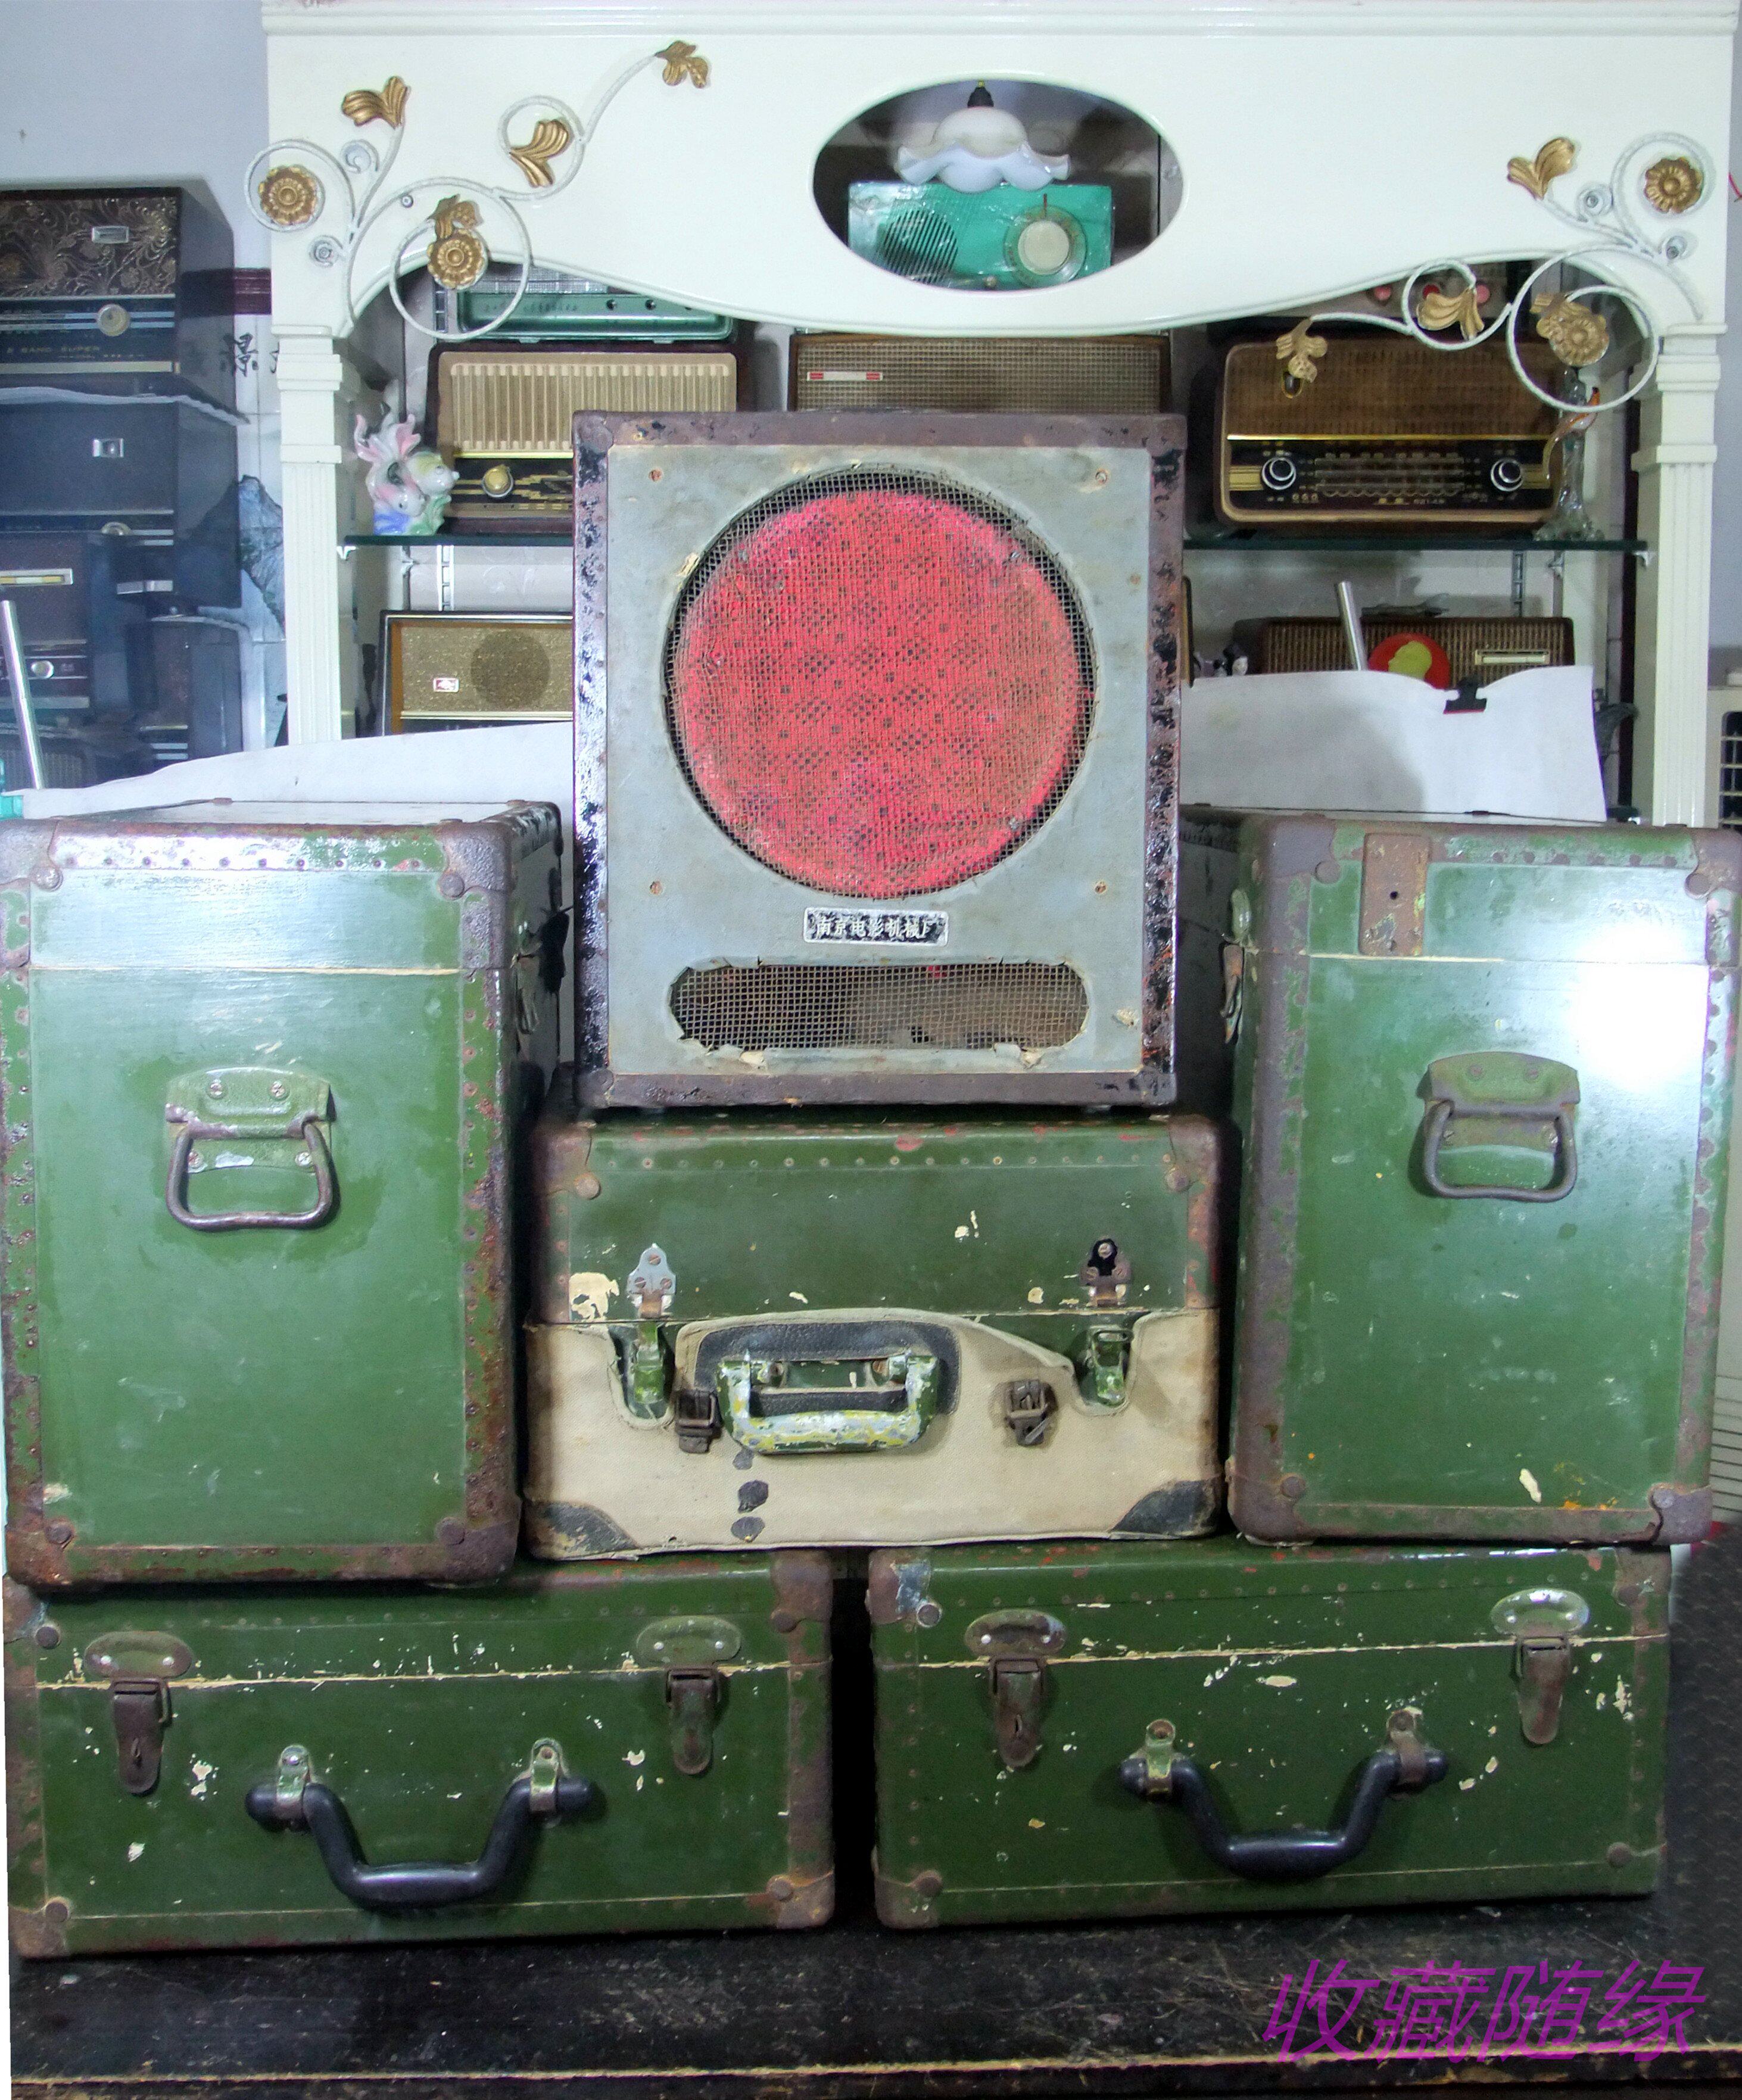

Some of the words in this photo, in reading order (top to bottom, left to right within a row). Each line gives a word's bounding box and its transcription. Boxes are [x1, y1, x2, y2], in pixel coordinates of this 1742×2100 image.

[815, 915, 934, 939] 南京电影机械厂
